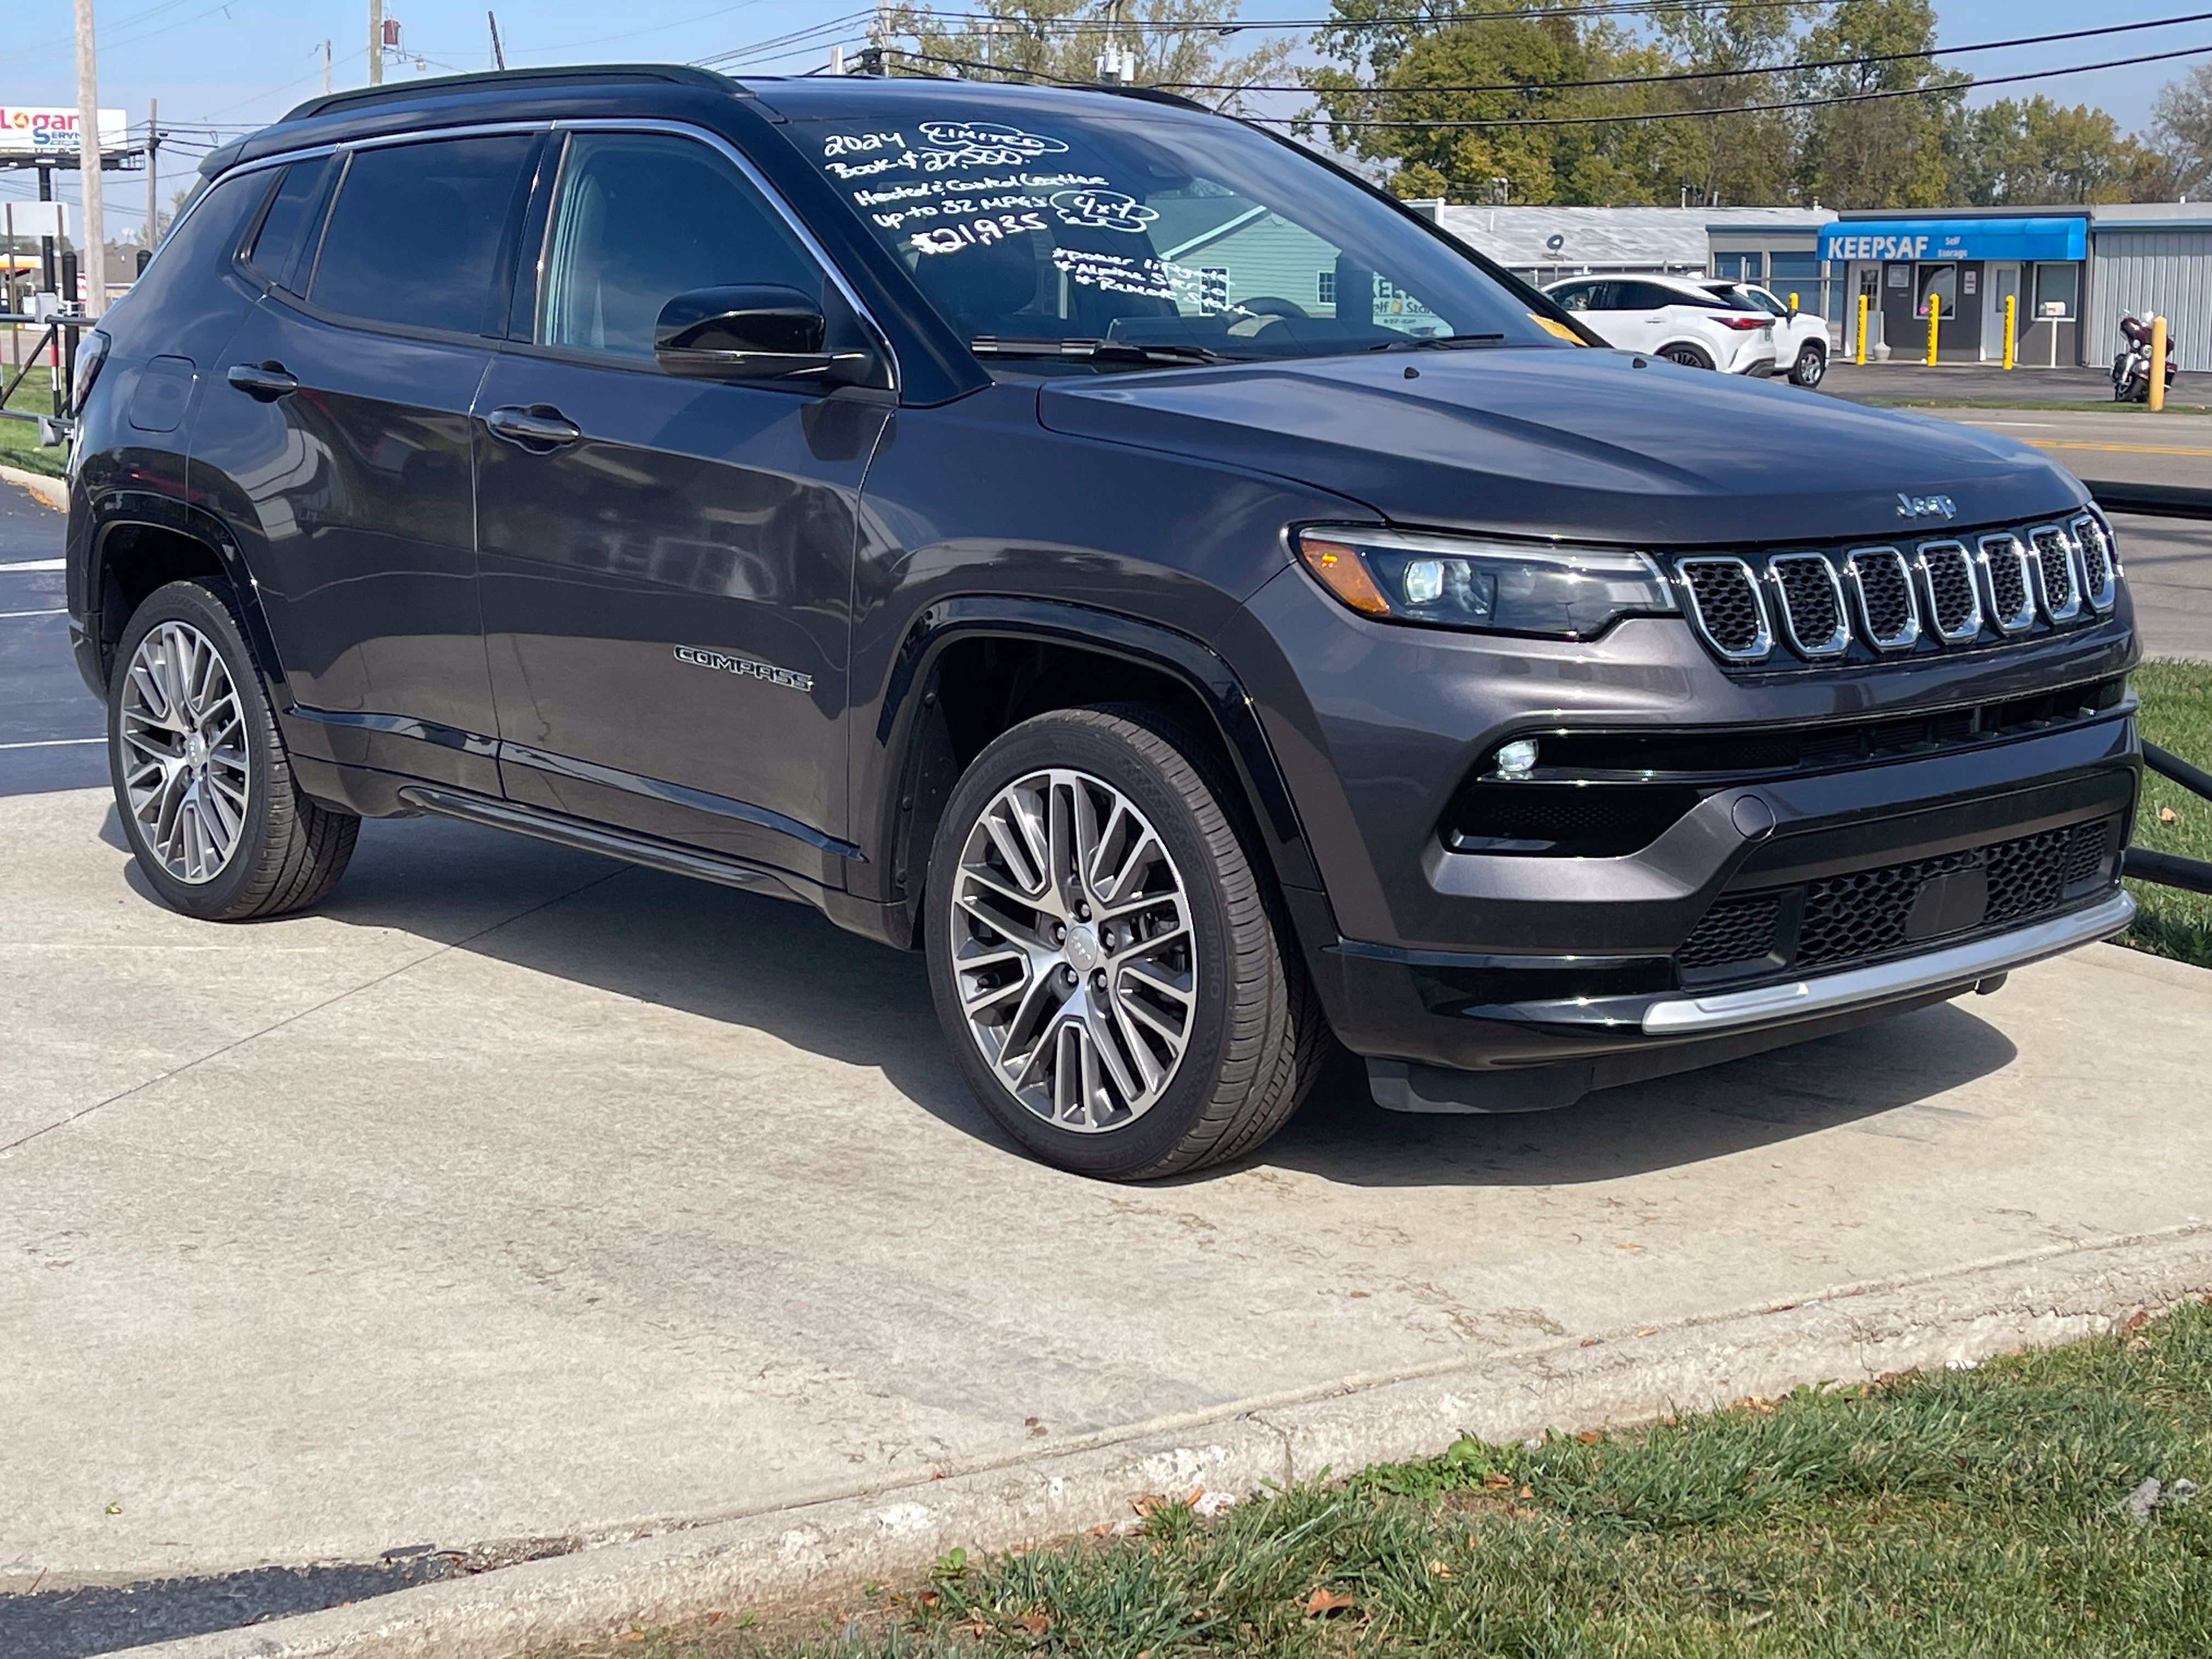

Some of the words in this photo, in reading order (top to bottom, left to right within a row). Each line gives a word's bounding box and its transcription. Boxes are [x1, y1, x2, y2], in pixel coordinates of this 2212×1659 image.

[824, 132, 906, 156] 2024
[932, 127, 1045, 148] LIMITED
[854, 183, 932, 206] Heated
[941, 199, 978, 213] 32
[1073, 196, 1132, 219] 4x4
[1828, 236, 1929, 258] KEEPSAF
[1897, 493, 1957, 520] Jeep
[673, 644, 815, 692] COMPASS
